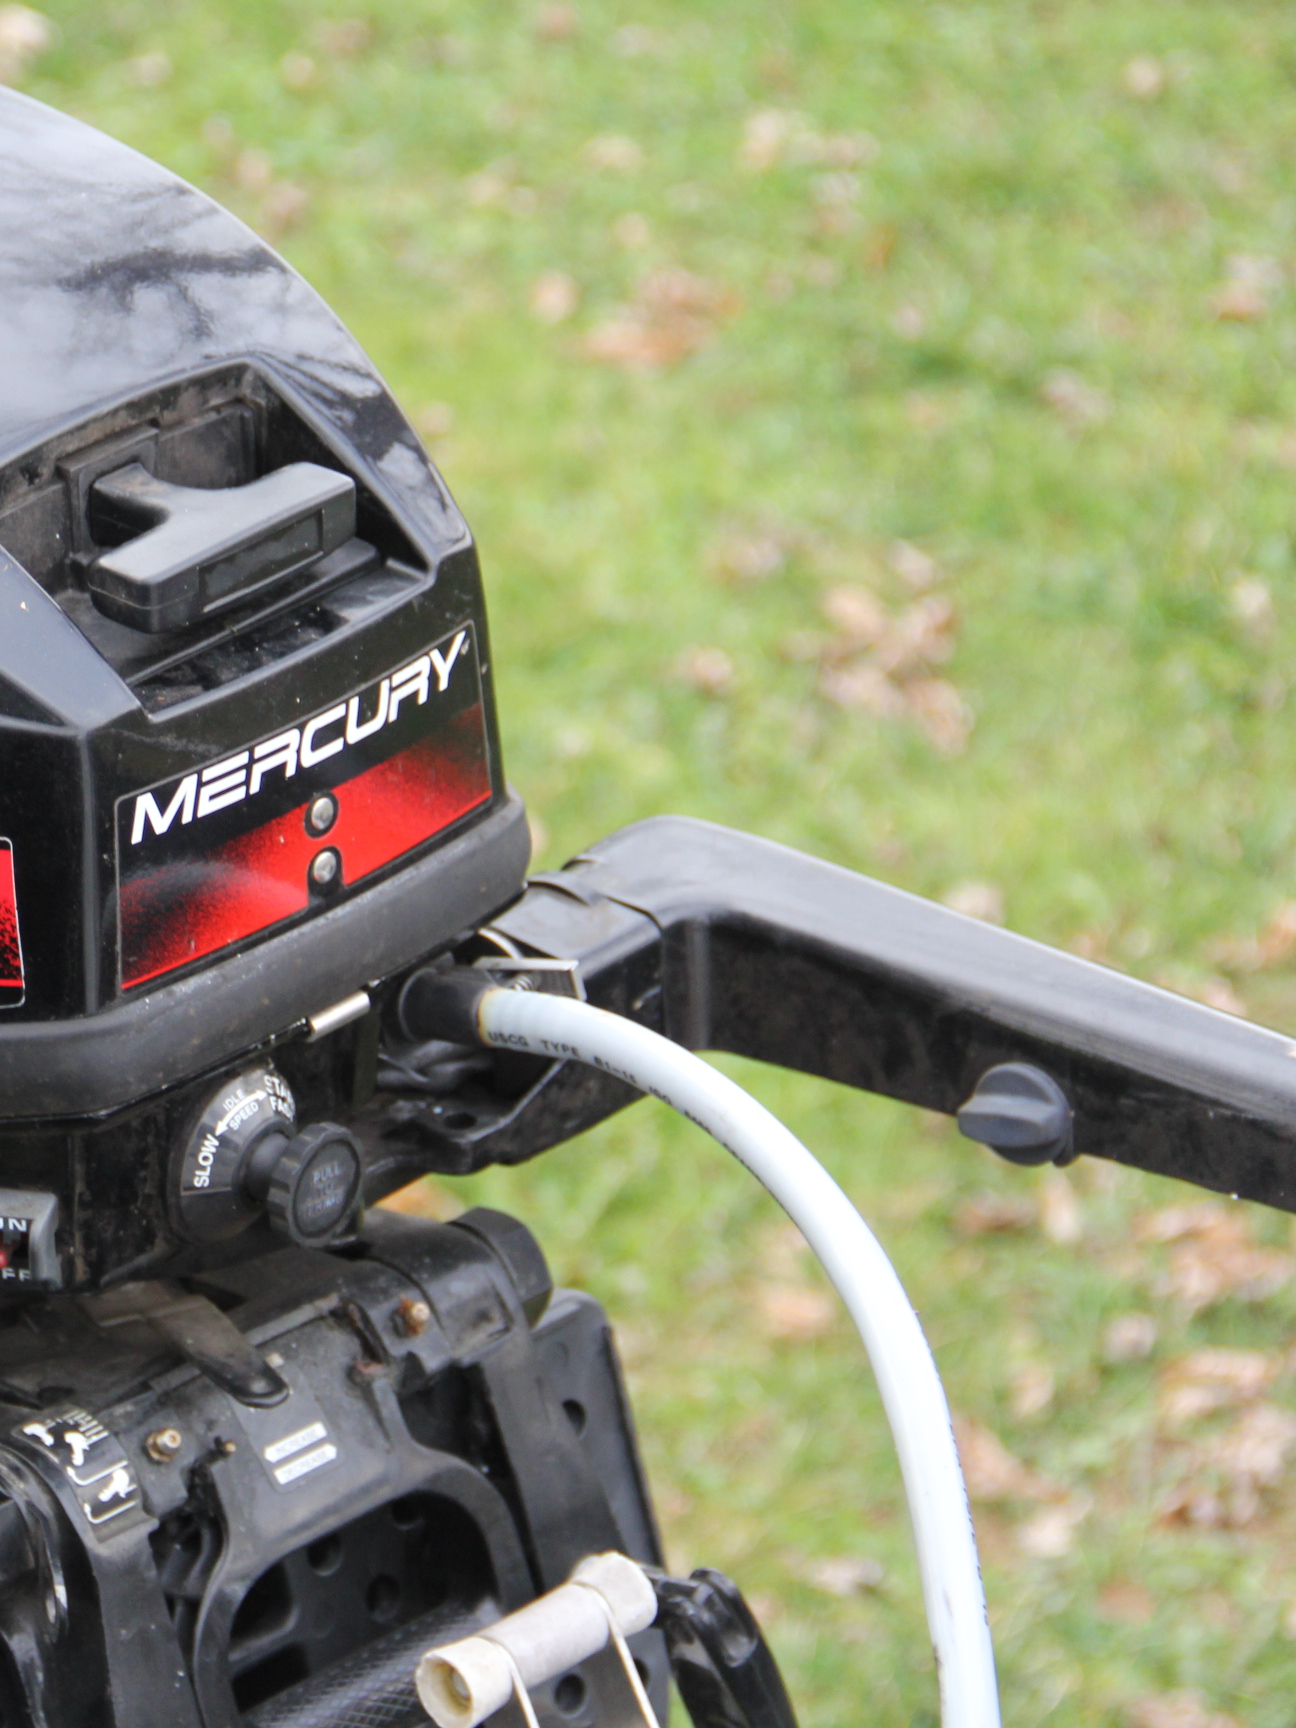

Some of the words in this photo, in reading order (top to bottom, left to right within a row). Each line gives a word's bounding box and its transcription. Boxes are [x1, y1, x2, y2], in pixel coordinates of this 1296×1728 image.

[130, 630, 466, 846] MERCURY
[489, 1031, 530, 1048] USCG
[540, 1038, 579, 1057] TYPE
[222, 1088, 247, 1112] IDLE
[229, 1101, 259, 1131] SPEED
[193, 1134, 220, 1189] SLOW
